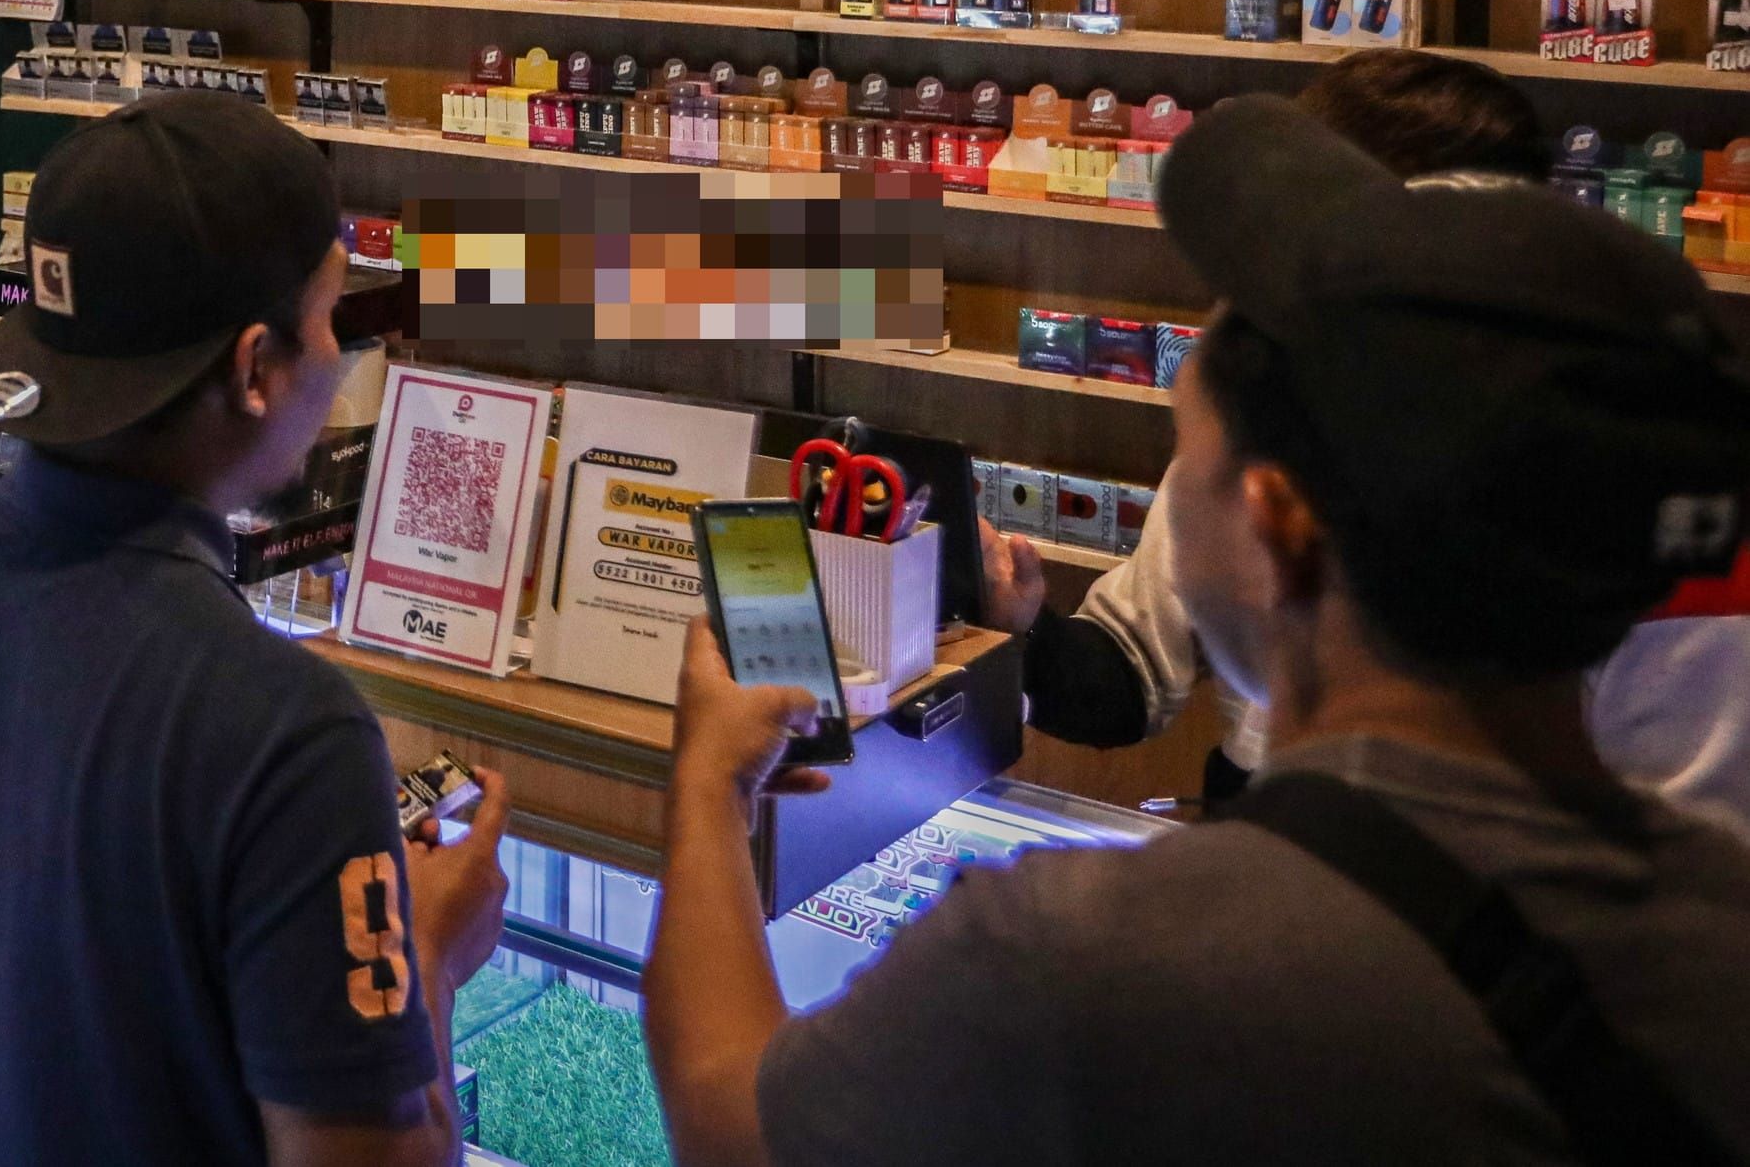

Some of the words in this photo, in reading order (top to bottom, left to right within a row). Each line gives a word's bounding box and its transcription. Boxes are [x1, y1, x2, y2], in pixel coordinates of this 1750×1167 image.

[586, 450, 616, 464] CARA
[618, 456, 672, 472] BAYARAN
[608, 530, 641, 547] WAR
[647, 538, 696, 556] VAPOR
[798, 896, 872, 935] NJOY
